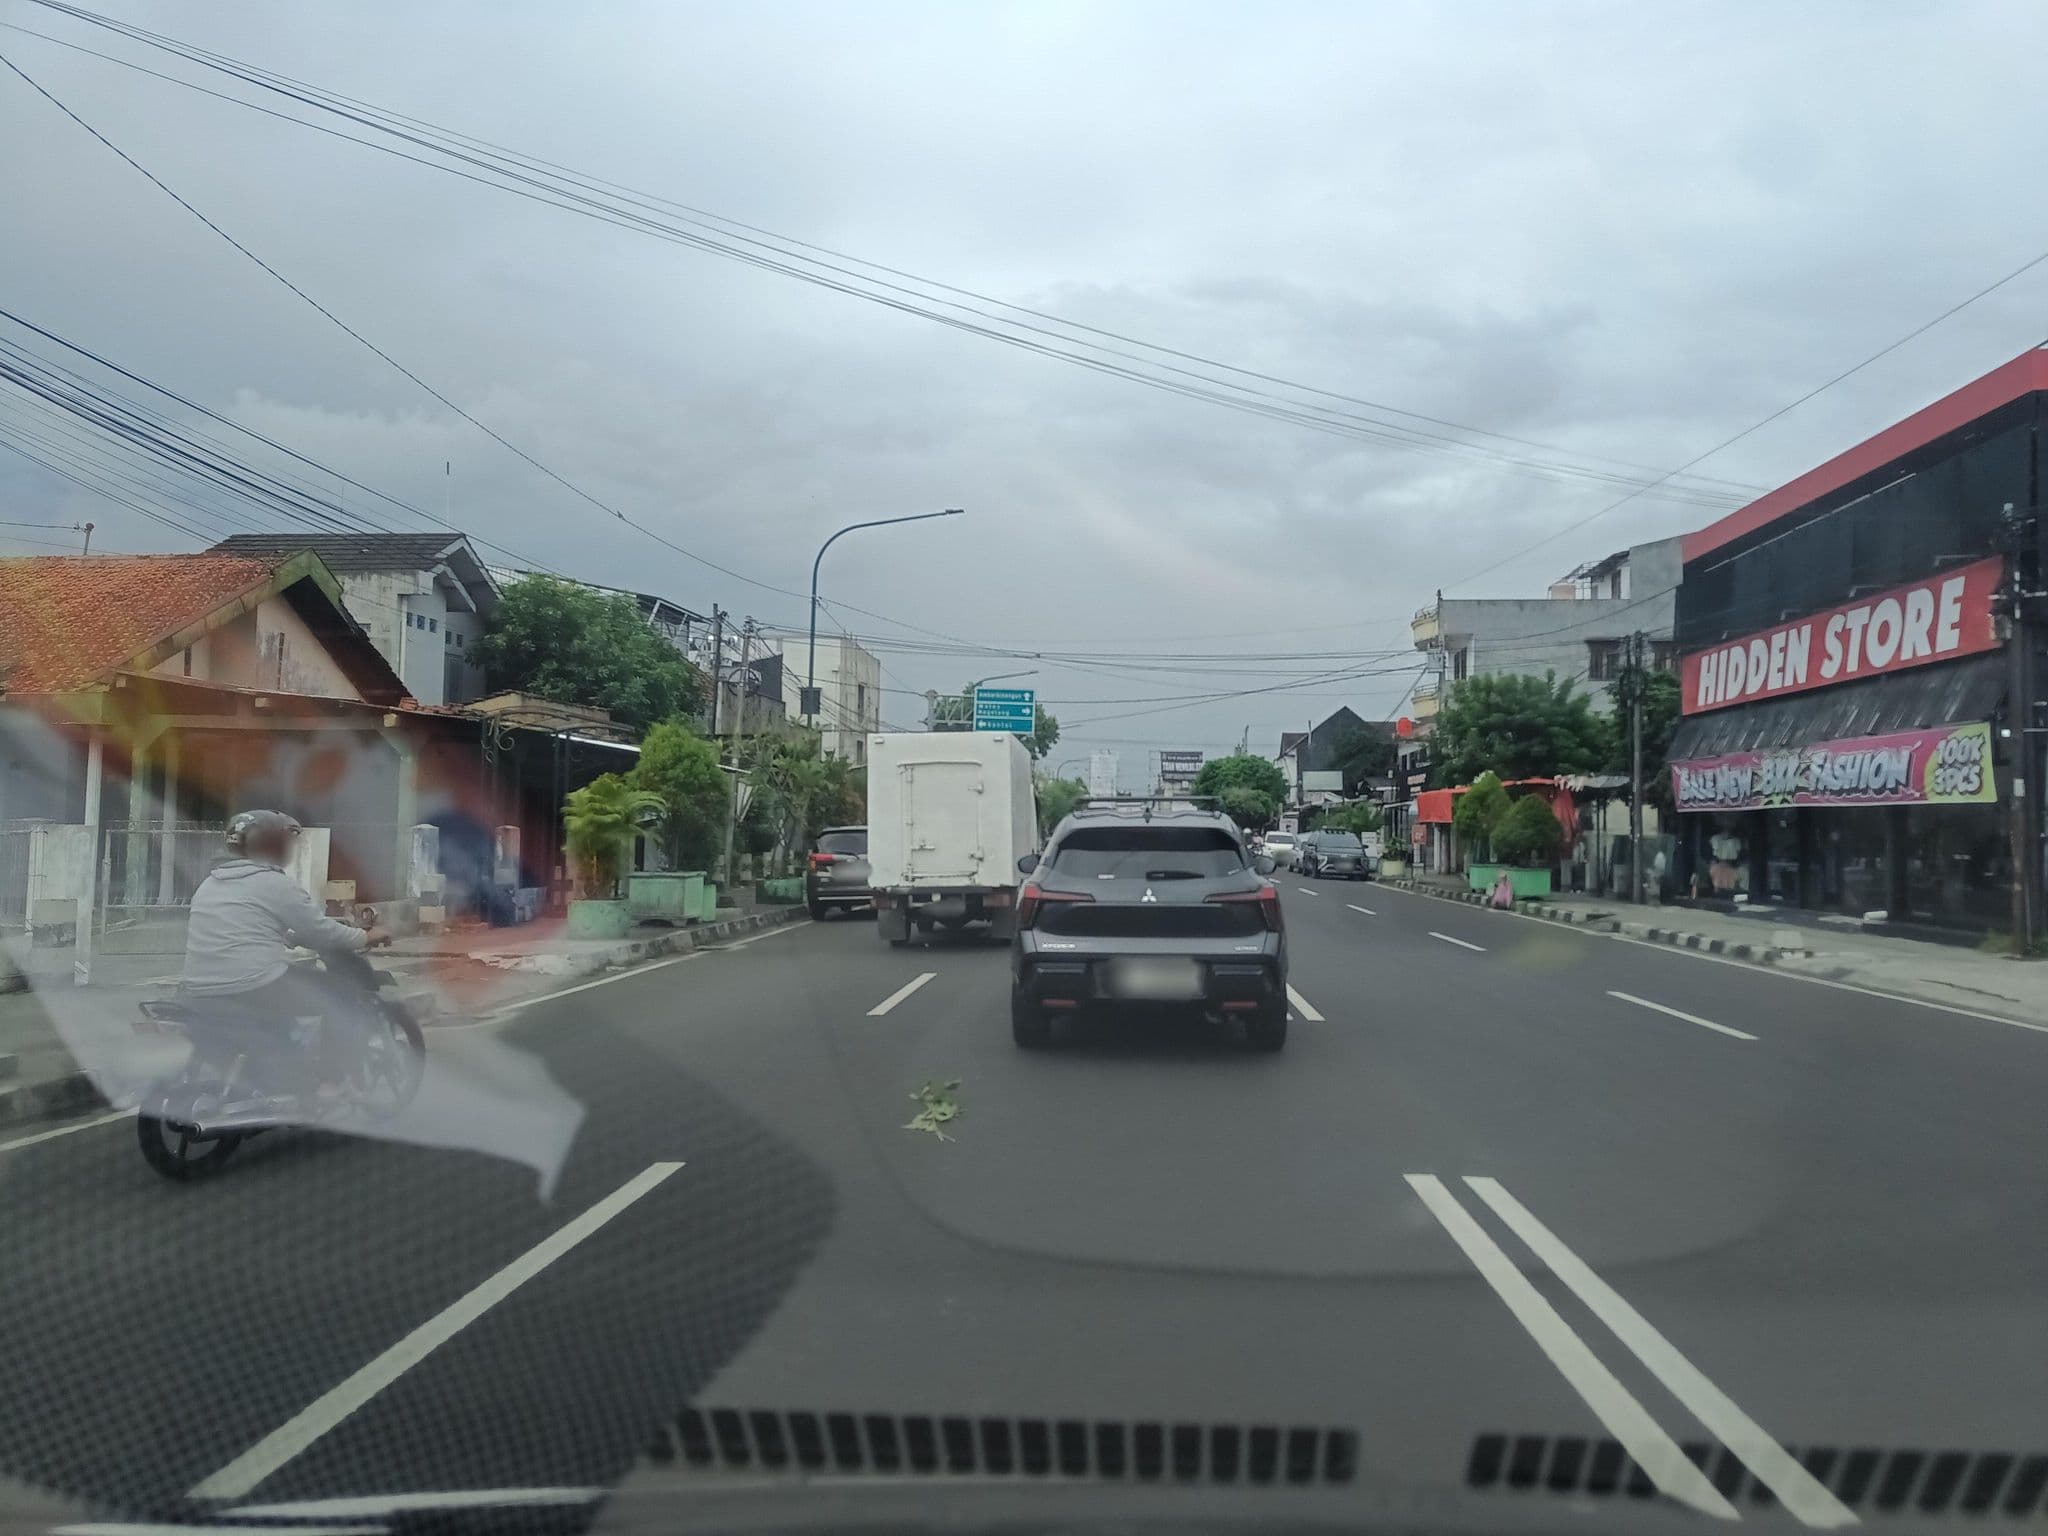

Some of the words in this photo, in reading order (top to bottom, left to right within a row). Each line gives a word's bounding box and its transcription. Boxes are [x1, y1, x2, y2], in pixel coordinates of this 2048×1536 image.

[1697, 624, 1812, 706] HIDDEN
[1819, 575, 1966, 678] STORE
[1715, 764, 1753, 801] NEW
[1808, 749, 1911, 793] FASHION
[1934, 764, 1982, 794] 3PCS
